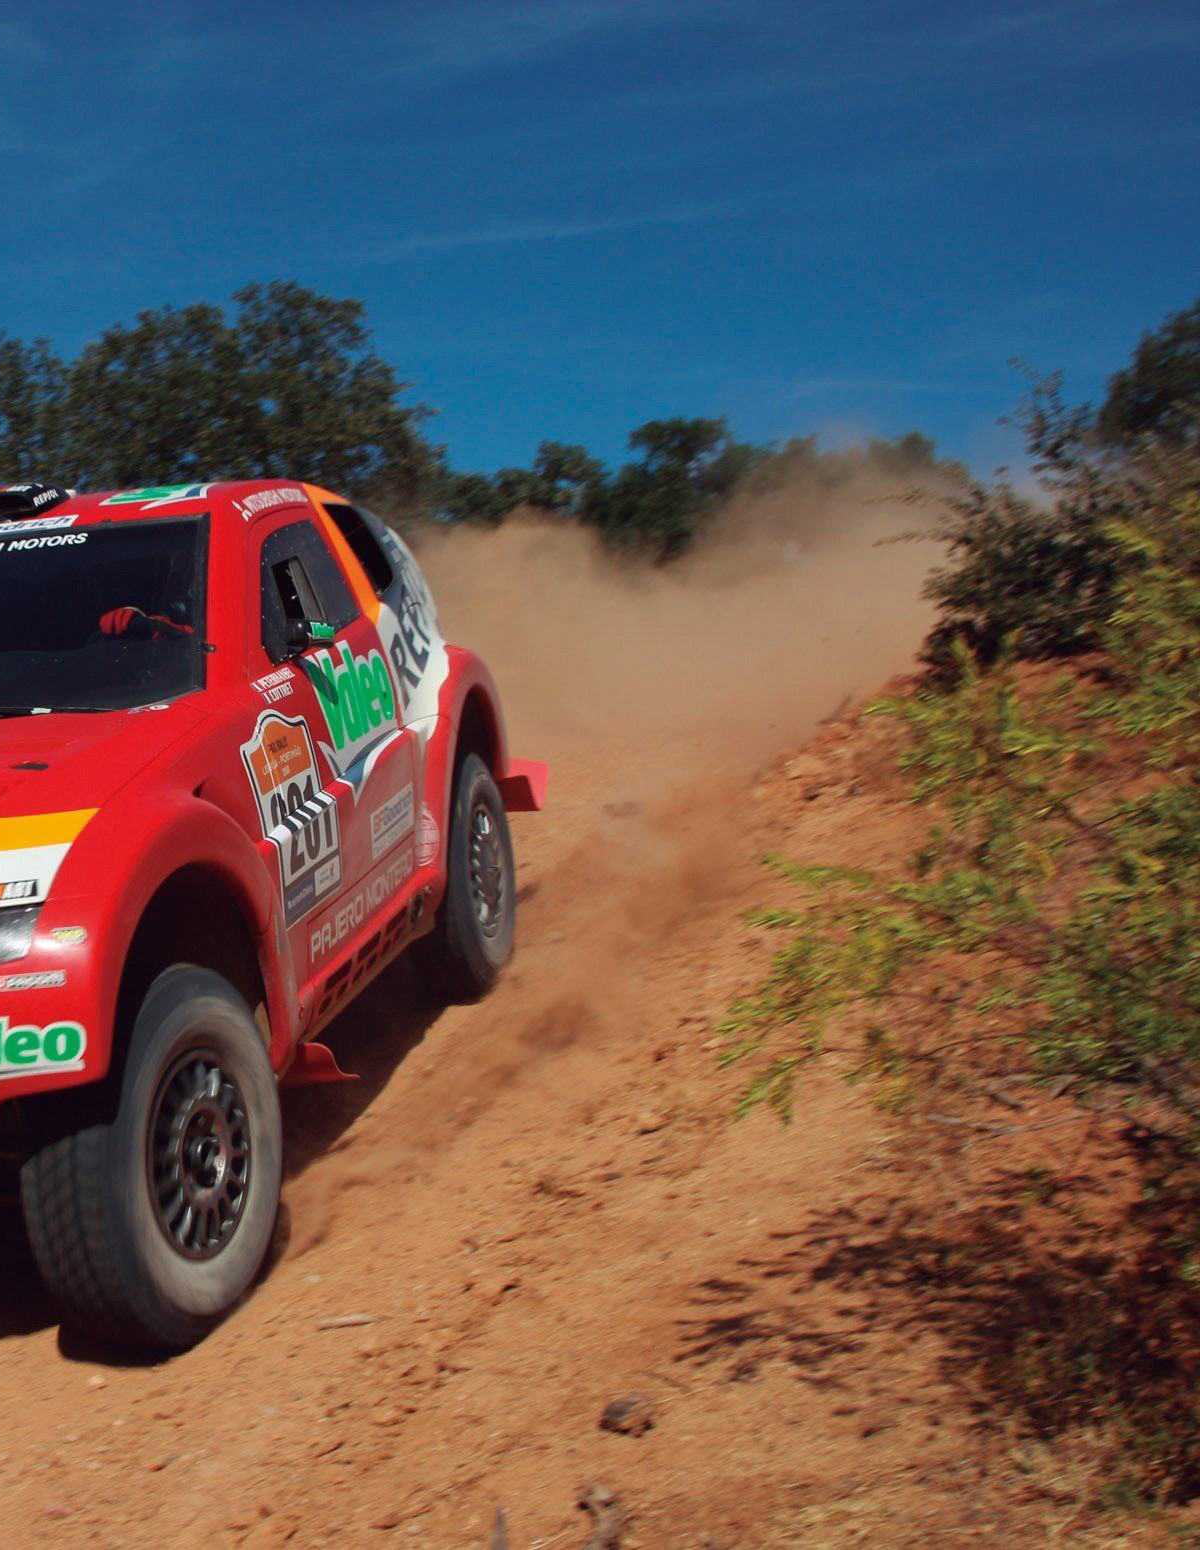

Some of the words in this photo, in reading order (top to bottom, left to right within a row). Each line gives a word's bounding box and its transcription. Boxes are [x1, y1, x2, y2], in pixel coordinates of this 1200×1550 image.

[33, 489, 59, 507] REPSOL
[7, 533, 89, 552] MOTORS
[305, 648, 395, 750] Valeo
[311, 894, 364, 964] PAJERO
